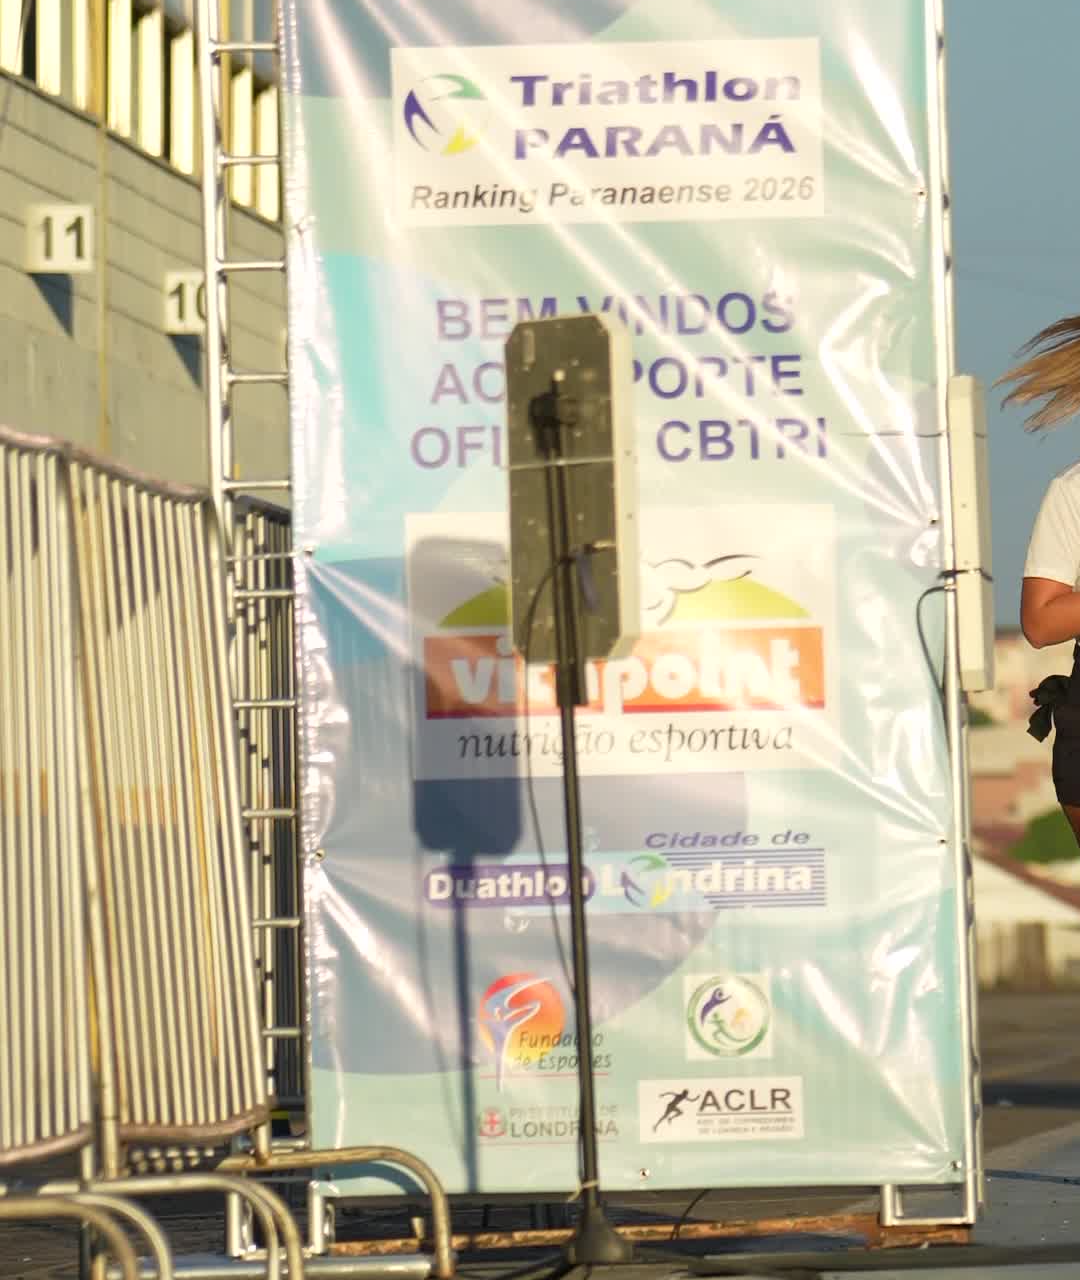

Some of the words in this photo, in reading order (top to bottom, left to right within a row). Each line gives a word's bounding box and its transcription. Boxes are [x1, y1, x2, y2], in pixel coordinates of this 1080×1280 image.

[510, 71, 801, 107] Triathlon
[514, 114, 797, 160] PARANÁ
[411, 183, 537, 213] Ranking
[742, 175, 815, 203] 2026
[41, 215, 84, 260] 11
[628, 722, 794, 762] esportiva
[645, 831, 764, 850] Cidade
[771, 829, 811, 846] de
[537, 1051, 613, 1072] Espoes
[699, 1087, 793, 1113] ACLR
[511, 1121, 619, 1138] LONDRNA
